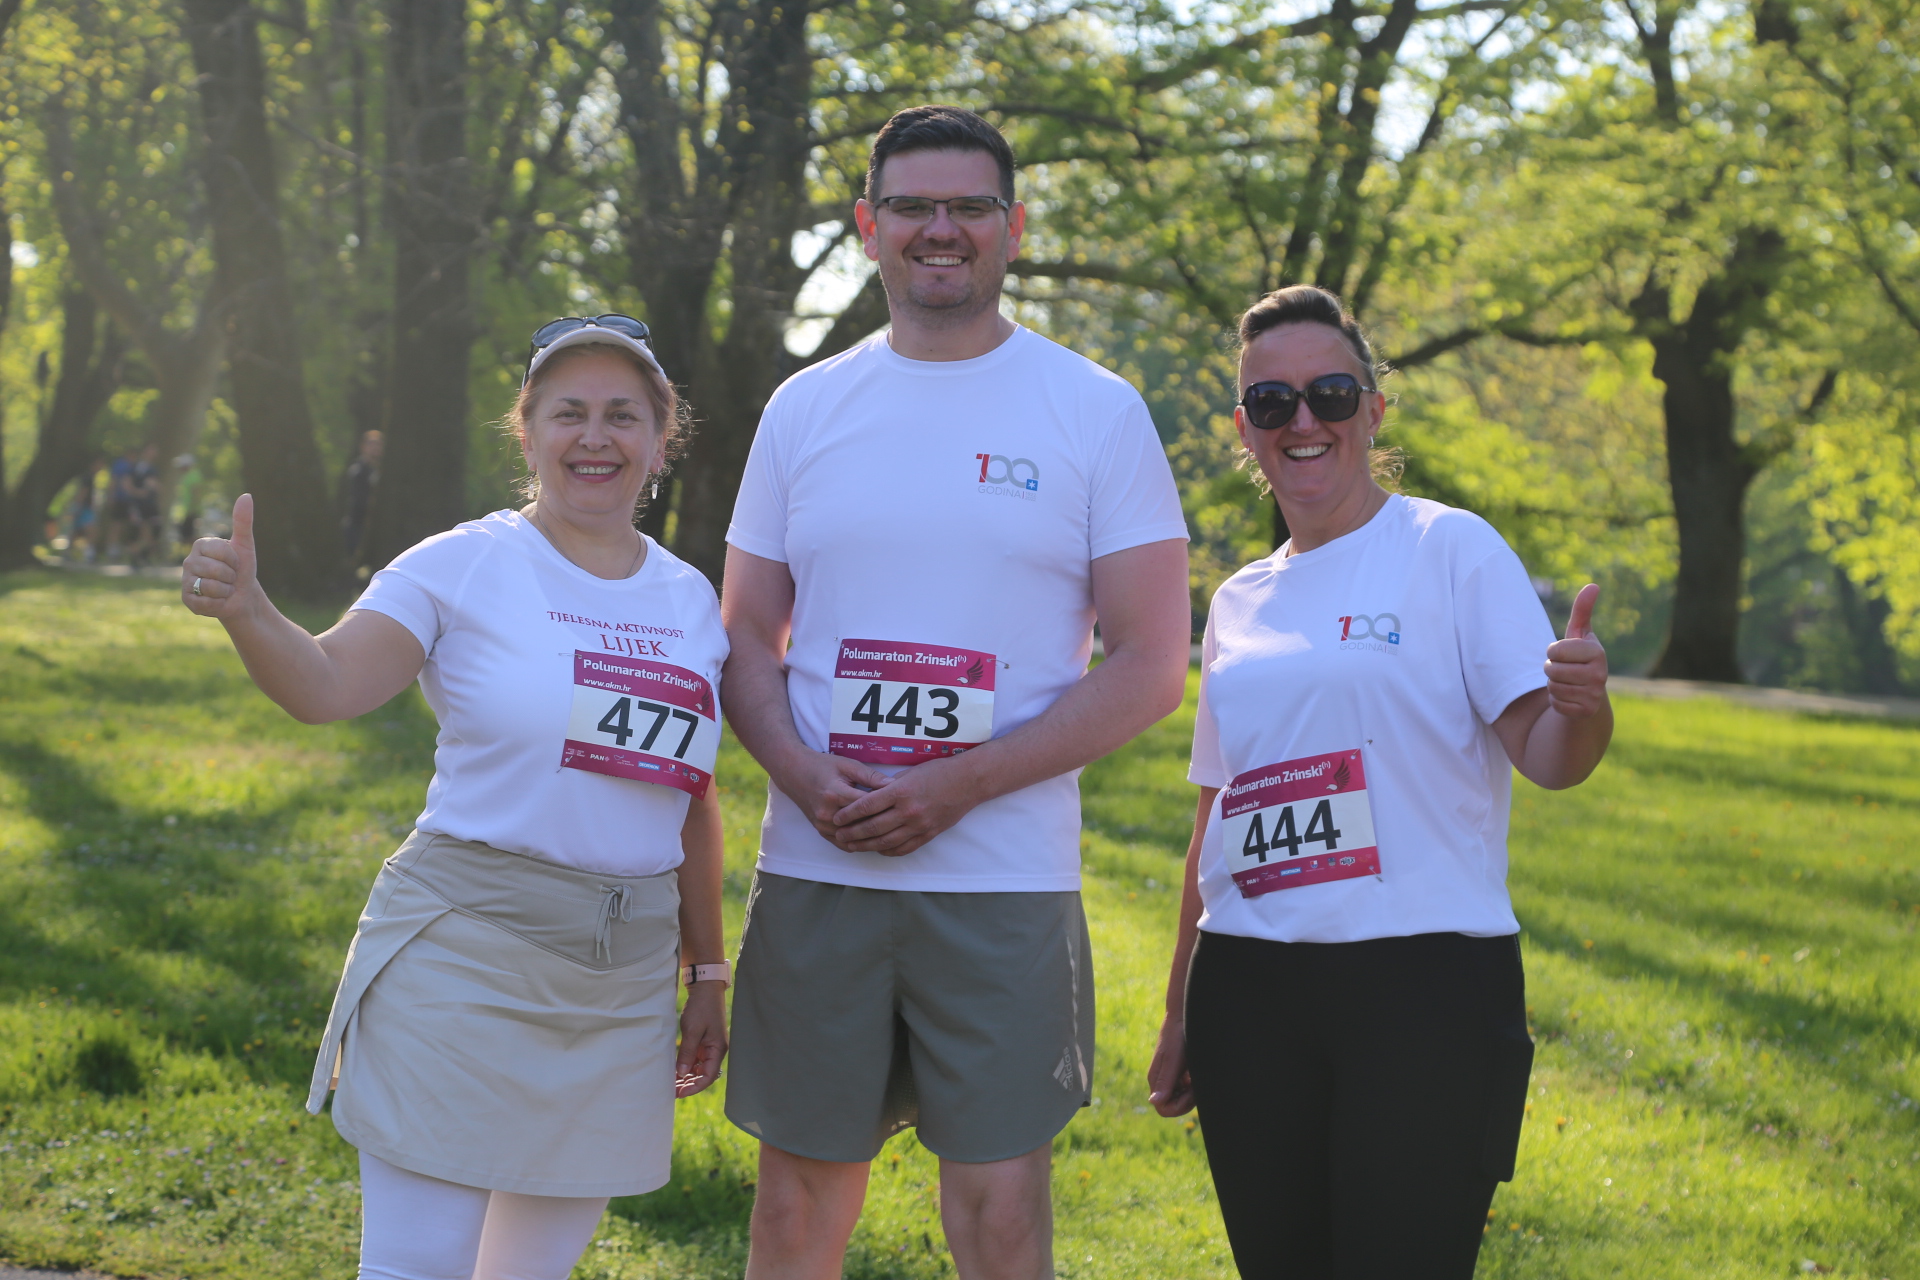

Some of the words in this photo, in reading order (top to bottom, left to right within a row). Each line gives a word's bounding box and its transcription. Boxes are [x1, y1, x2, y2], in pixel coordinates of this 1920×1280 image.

[978, 484, 1022, 499] GODINA
[546, 610, 613, 631] TJELESNA
[614, 622, 685, 640] AKTIVNOST
[599, 633, 669, 658] LIJEK
[842, 647, 913, 664] Polumaraton
[1339, 642, 1384, 653] GODINA
[583, 659, 662, 682] Polumaraton
[840, 669, 882, 678] www.akm.hr
[583, 678, 632, 693] www.akm.hr
[851, 683, 960, 739] 443
[596, 696, 699, 760] 477
[589, 753, 605, 761] PAN
[1226, 775, 1282, 799] Polumaraton
[1226, 799, 1261, 816] www.akm.hr
[1242, 799, 1342, 864] 444
[1063, 1046, 1074, 1092] adidas
